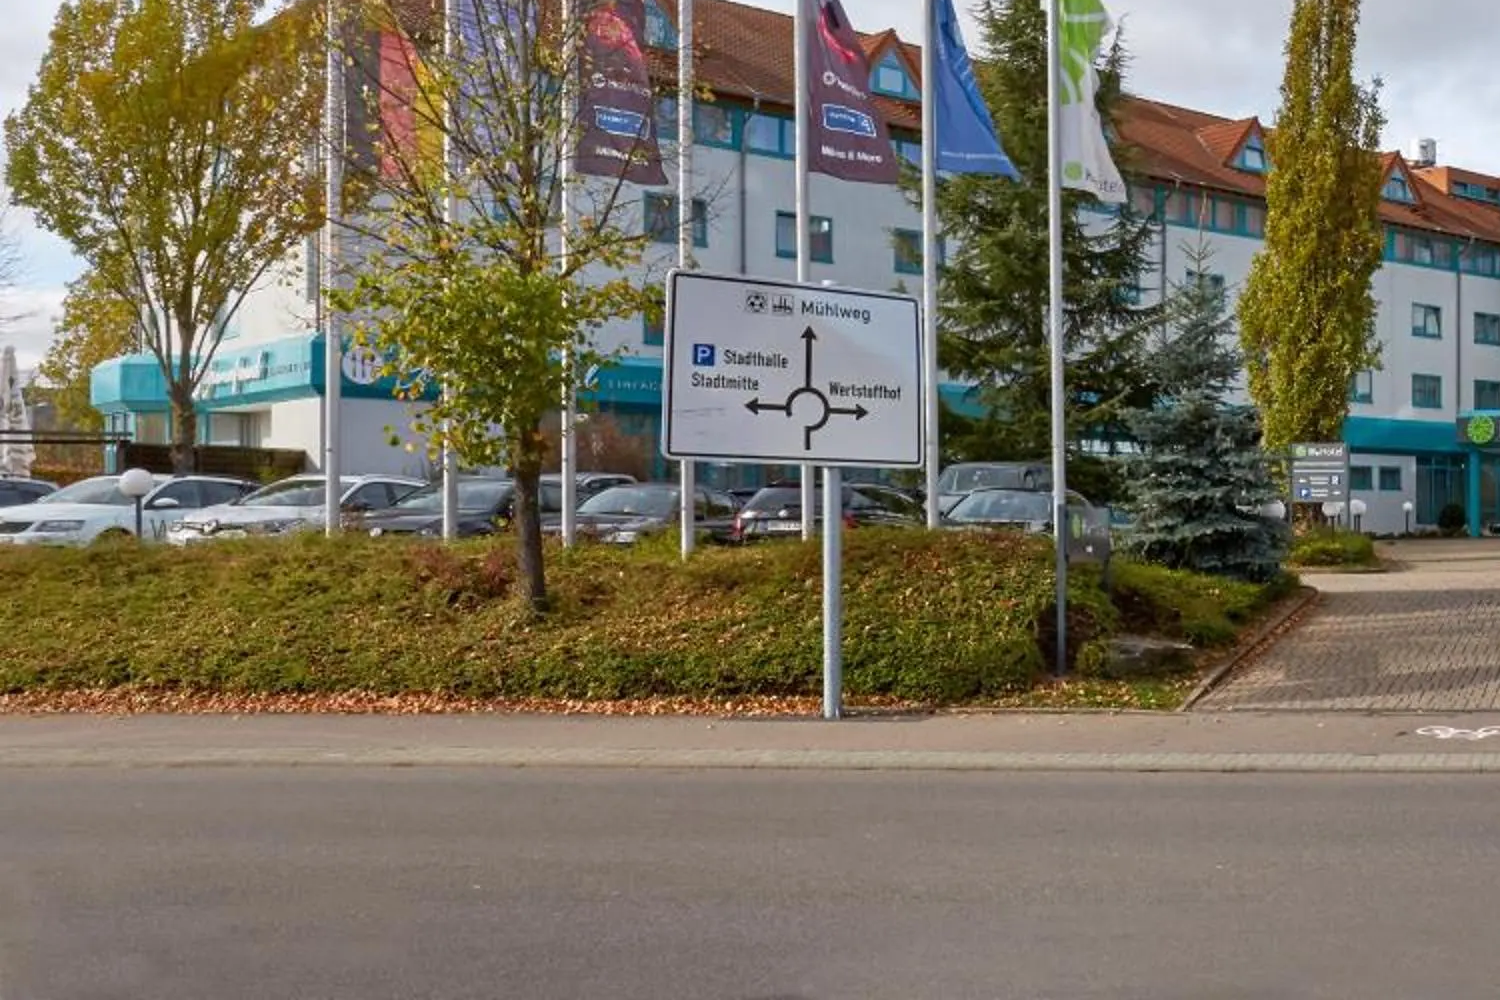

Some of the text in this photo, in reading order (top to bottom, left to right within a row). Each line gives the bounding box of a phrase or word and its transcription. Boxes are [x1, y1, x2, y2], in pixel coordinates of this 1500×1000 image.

[801, 301, 871, 325] Mühlweg
[696, 346, 789, 368] P Stadthalle
[691, 371, 759, 391] Stadtmitte
[829, 381, 901, 399] Wertstoffhof
